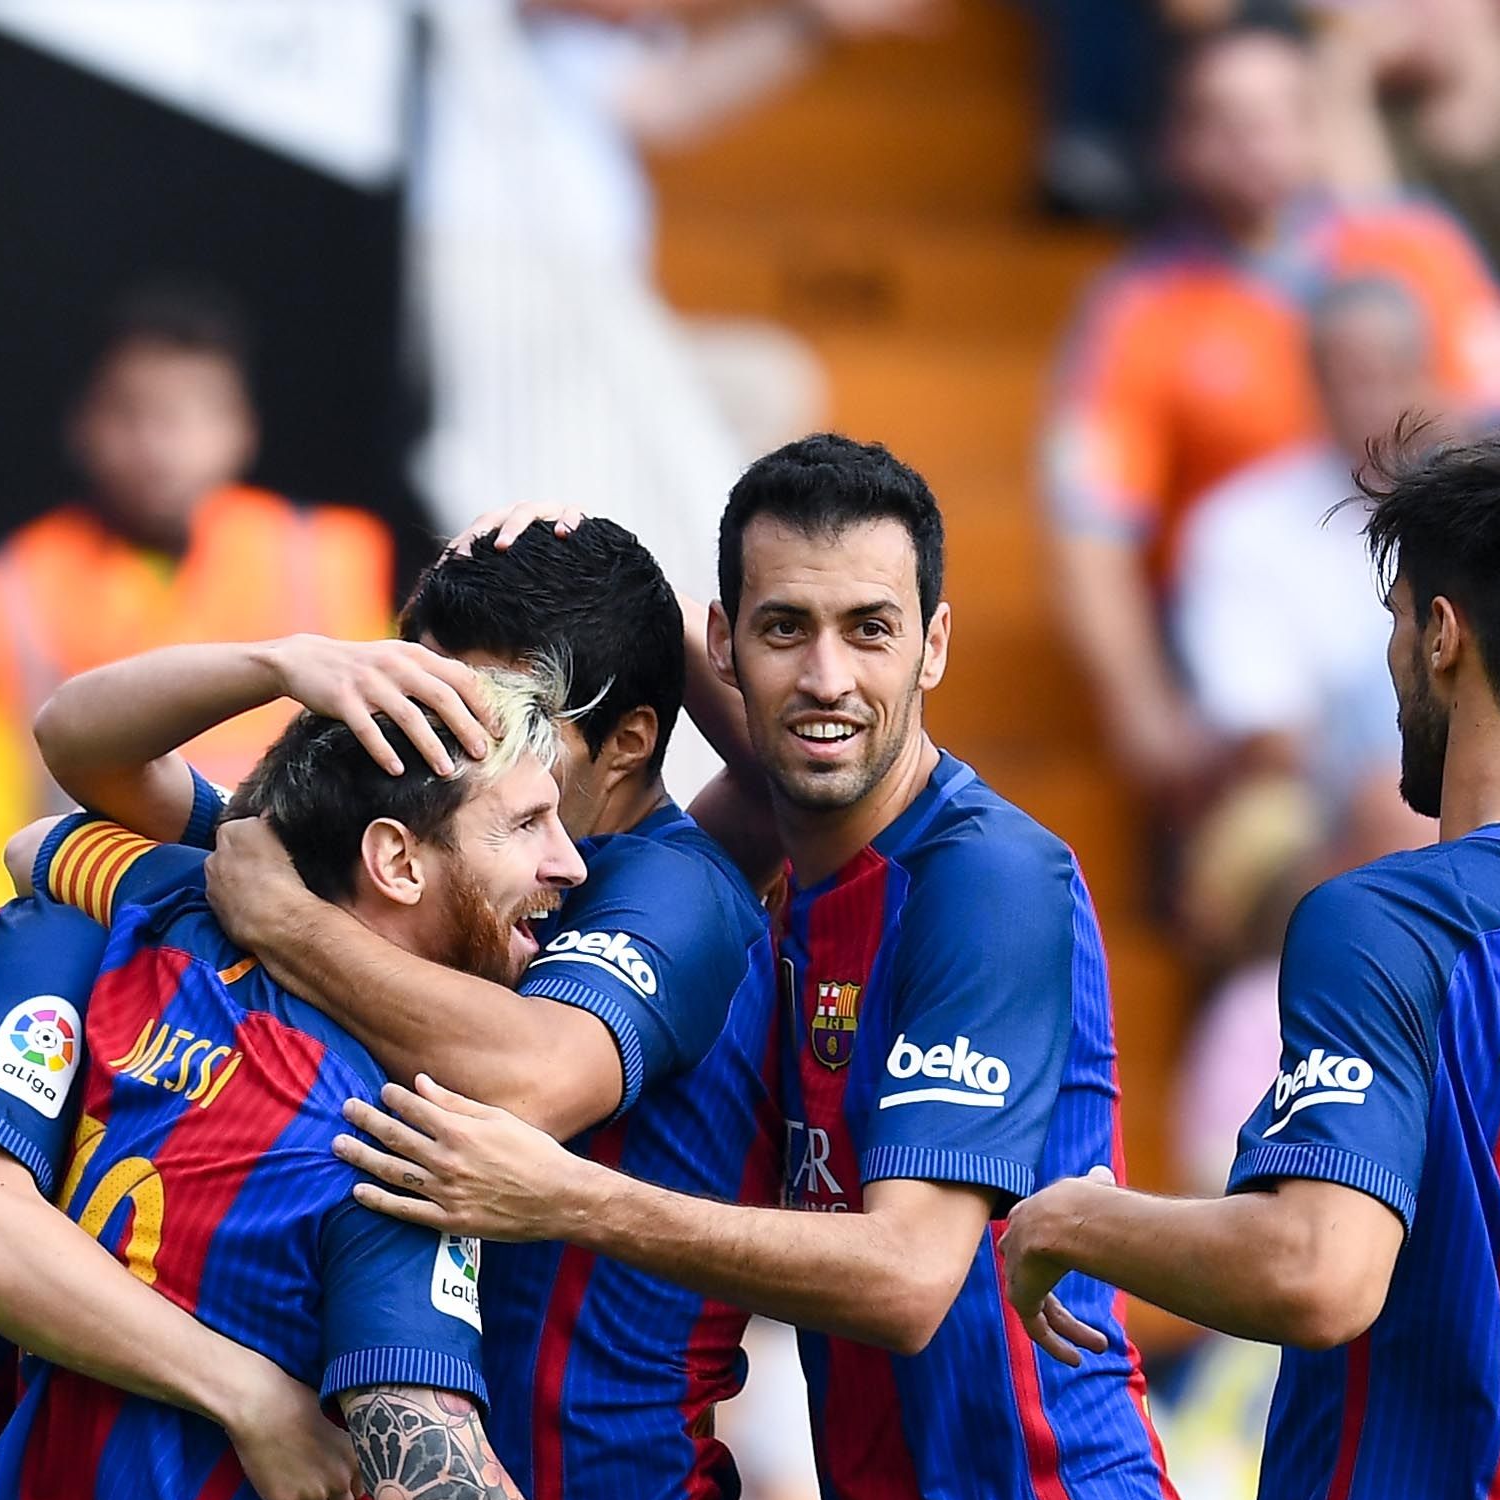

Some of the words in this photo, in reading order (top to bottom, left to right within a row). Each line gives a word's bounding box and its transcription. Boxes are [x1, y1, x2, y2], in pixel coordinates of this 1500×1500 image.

[108, 1018, 244, 1109] MESSI
[886, 1033, 1011, 1094] beko
[1274, 1048, 1374, 1110] beko
